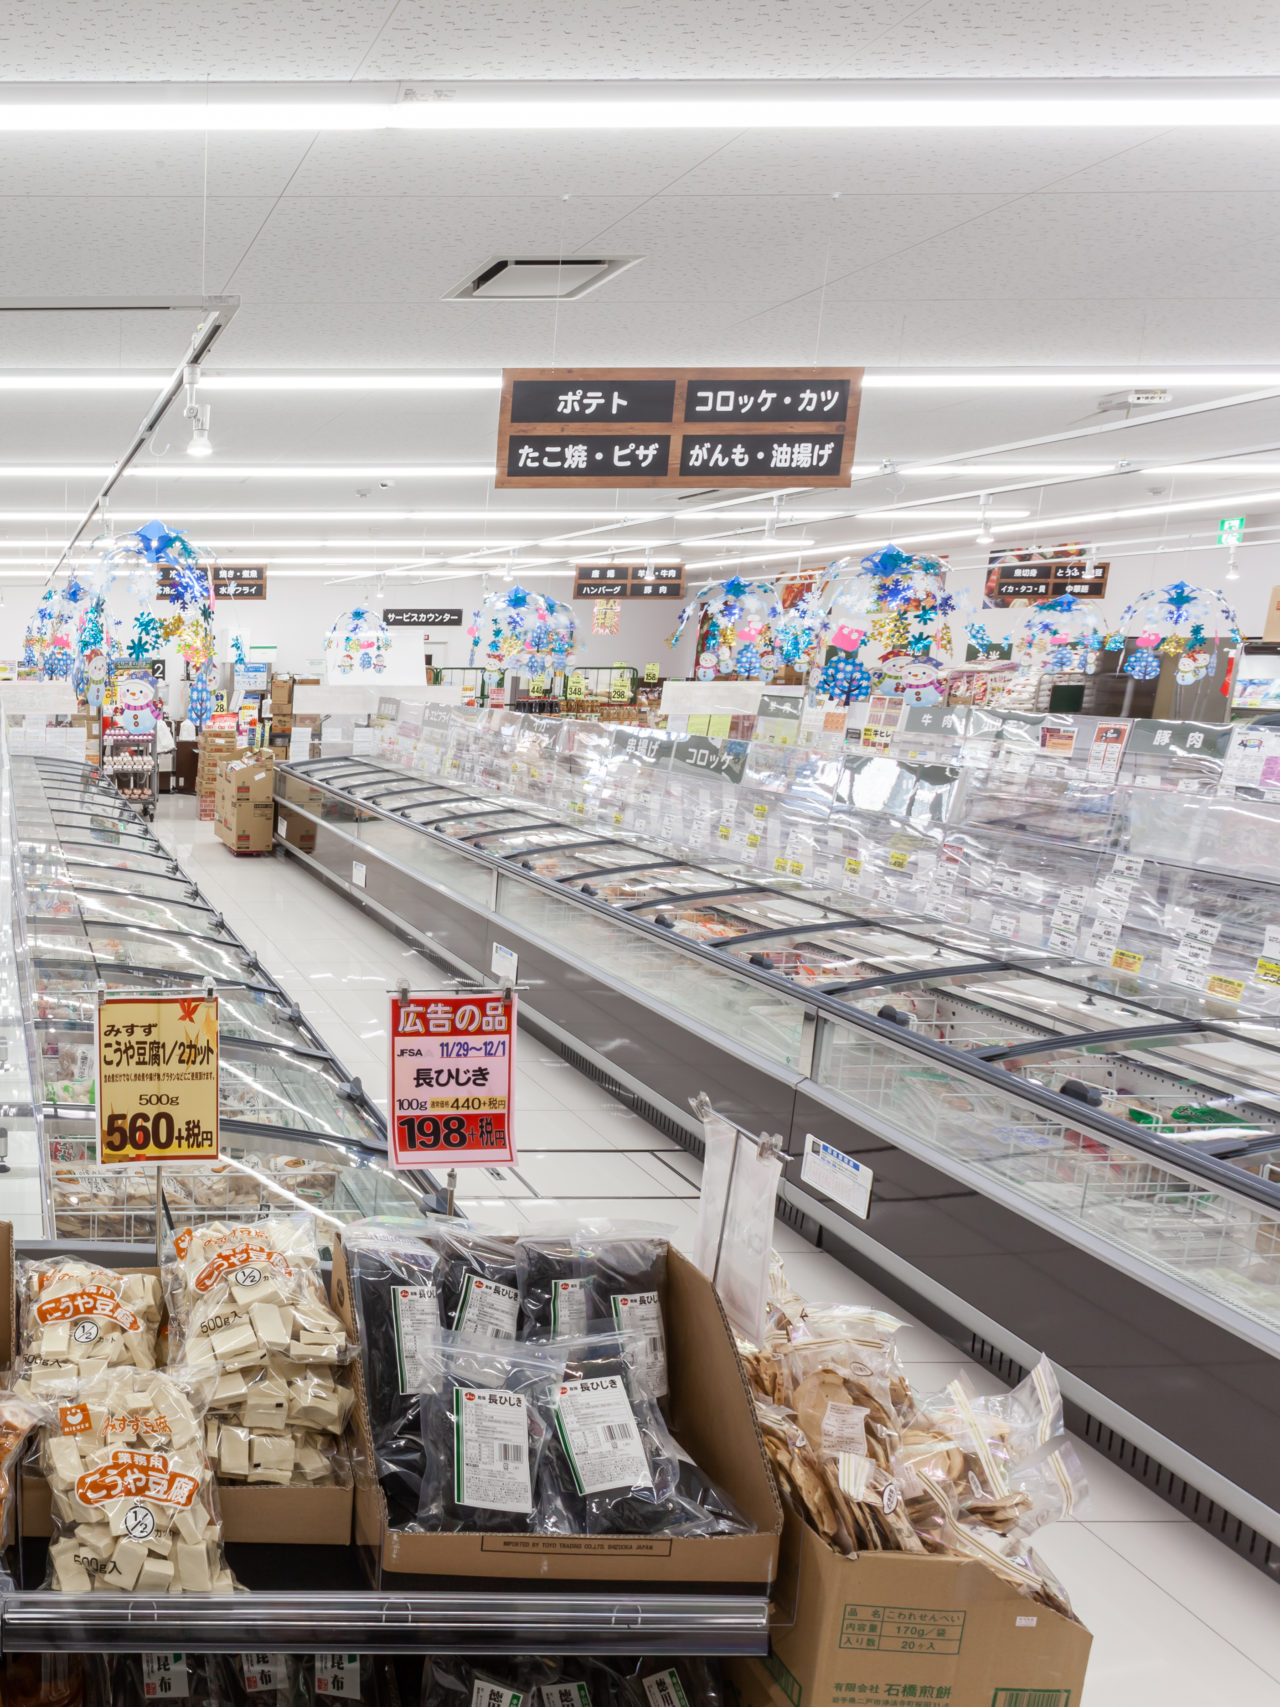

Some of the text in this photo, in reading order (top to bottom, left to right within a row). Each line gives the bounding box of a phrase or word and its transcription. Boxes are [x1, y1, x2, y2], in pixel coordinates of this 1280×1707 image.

[556, 389, 628, 415] ポテト
[695, 389, 840, 413] コロッケ・カツ
[518, 443, 660, 469] たこ焼・ピザ
[689, 442, 835, 468] がんも・油揚げ
[638, 569, 677, 578] 羊・牛肉
[1056, 568, 1103, 577] とうふ・豆
[582, 586, 622, 595] ハンバーグ
[387, 611, 459, 624] サービスカウンター
[154, 662, 164, 677] 2
[612, 690, 625, 699] 298
[1152, 729, 1205, 749] 豚肉
[686, 748, 733, 770] コロッケ
[398, 1001, 508, 1034] 広告の品
[104, 1023, 158, 1037] みすず
[397, 1048, 423, 1057] JFSA
[414, 1066, 490, 1088] 長ひじき
[138, 1094, 180, 1106] 500g
[397, 1098, 428, 1111] 100g
[42, 1295, 136, 1330] こうや豆腐
[200, 1311, 243, 1334] 500g入
[580, 1379, 618, 1392] 長ひじき
[101, 1416, 172, 1437] みすず豆腐
[117, 1452, 164, 1468] 業務用
[84, 1468, 196, 1505] こうや豆腐
[73, 1554, 123, 1576] 500g入
[887, 1611, 961, 1623] こわれせんべい
[845, 1622, 878, 1633] 内容量
[844, 1636, 876, 1647] 入り数
[157, 1655, 171, 1693] 昆布
[834, 1682, 952, 1699] 有限会社 石橋煎餅
